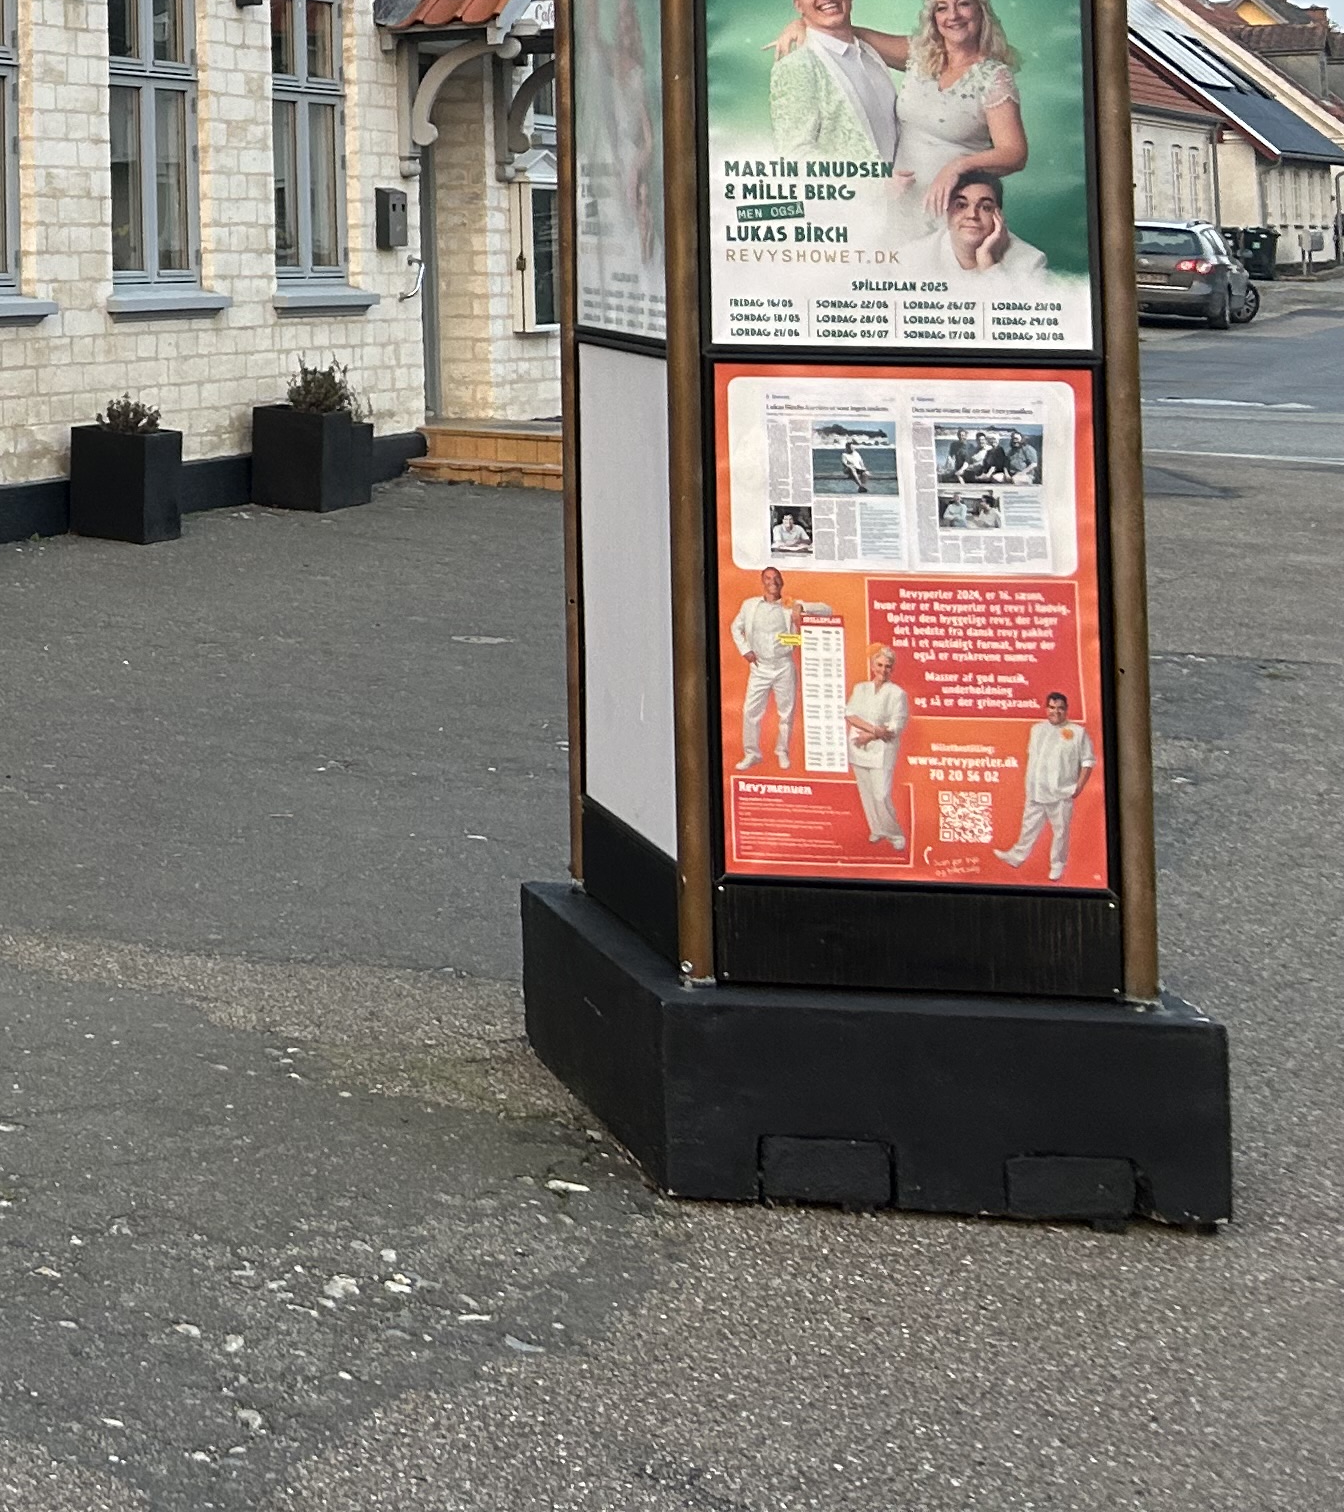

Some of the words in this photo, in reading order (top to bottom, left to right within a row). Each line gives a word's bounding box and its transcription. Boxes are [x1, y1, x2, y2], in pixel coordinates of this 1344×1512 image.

[724, 157, 799, 178] MARTIN
[806, 161, 894, 178] KNUDSEN
[724, 183, 736, 200] &
[742, 179, 798, 200] MILLE
[805, 184, 856, 201] BERG
[737, 208, 763, 220] MEN
[770, 202, 804, 218] OGSÅ
[725, 225, 788, 242] LUKAS
[794, 222, 848, 243] BIRCH
[725, 248, 900, 264] REVYSHOWET.DK
[851, 279, 916, 291] SPILLEPLAN
[920, 281, 949, 292] 2025
[899, 589, 952, 600] Revyperler
[907, 756, 1018, 768] www.revyperler.dk
[948, 770, 963, 781] 20
[984, 771, 999, 783] 02
[738, 781, 812, 795] Revymenuen
